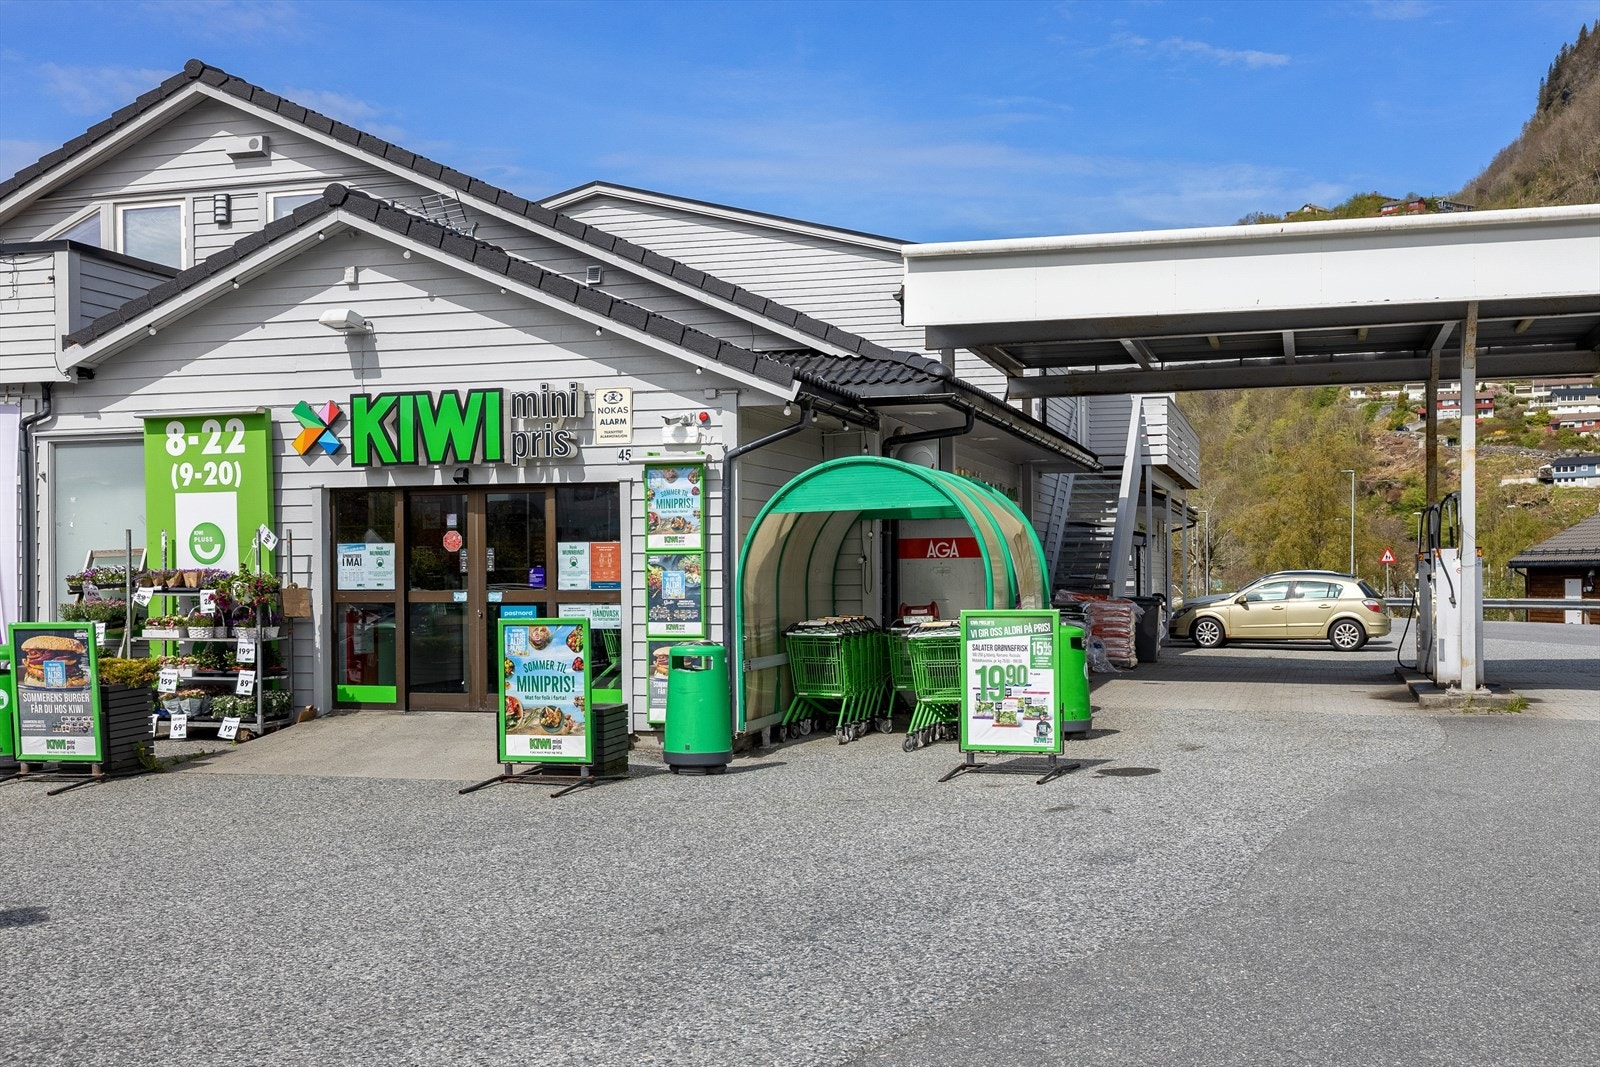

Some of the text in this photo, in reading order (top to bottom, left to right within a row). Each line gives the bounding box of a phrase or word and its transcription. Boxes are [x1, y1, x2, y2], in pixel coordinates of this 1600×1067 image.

[511, 382, 578, 418] mini
[597, 406, 629, 414] NOKAS
[350, 388, 504, 467] KIWI
[599, 418, 627, 426] ALARM
[165, 418, 246, 456] 8-22
[511, 422, 572, 466] pris
[618, 449, 632, 461] 45
[171, 461, 242, 490] (9-20)
[660, 488, 689, 498] SOMMER TIL
[656, 498, 694, 510] MINIPRIS!
[927, 539, 959, 558] AGA
[346, 558, 362, 567] MAI
[592, 608, 620, 618] HÅNDVASK
[978, 628, 989, 638] GIR
[990, 627, 1003, 637] OSS
[1003, 625, 1022, 635] ALDRI
[1023, 622, 1033, 633] PÅ
[1034, 623, 1051, 633] PRIS!
[972, 644, 993, 652] SALATER
[523, 660, 567, 674] SOMMER TIL
[160, 678, 173, 686] 159
[240, 679, 249, 687] 89
[517, 675, 575, 692] MINIPRIS!
[22, 692, 90, 702] SOMMERENS BURGER
[31, 702, 84, 713] FÅR DU HOS KIWI
[173, 723, 183, 731] 69
[223, 725, 232, 733] 19
[46, 739, 66, 750] KIWI
[529, 738, 551, 750] KIWI
